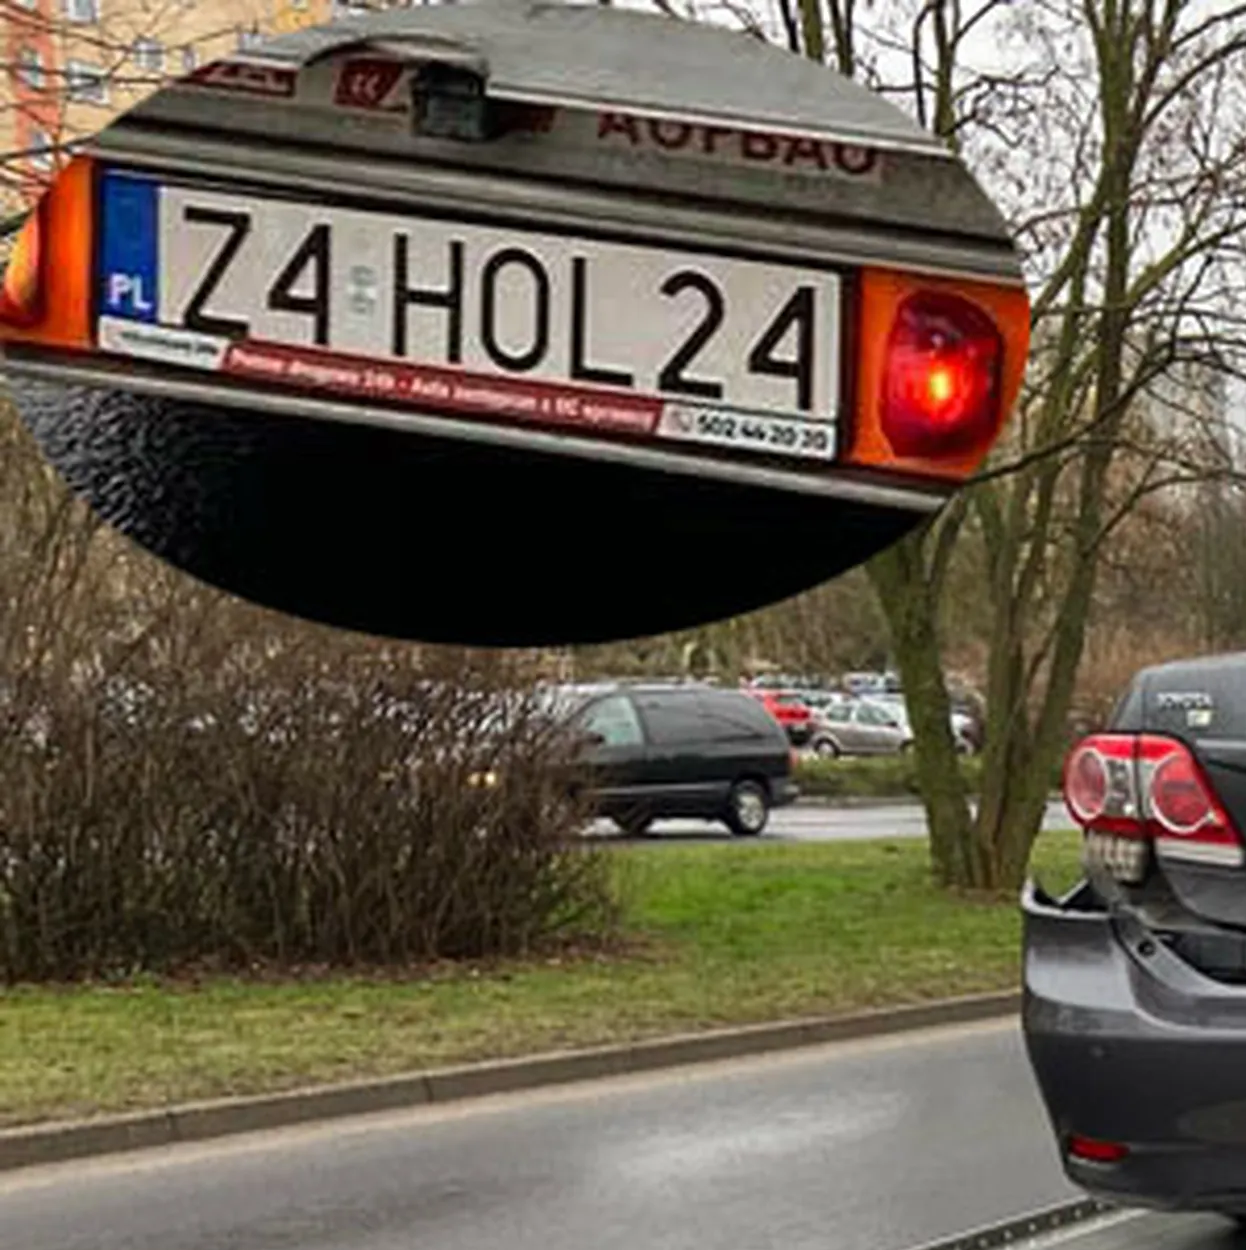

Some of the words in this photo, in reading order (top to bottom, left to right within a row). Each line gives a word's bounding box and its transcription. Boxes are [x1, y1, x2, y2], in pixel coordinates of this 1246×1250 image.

[109, 273, 153, 309] PL
[183, 206, 332, 345] Z4
[393, 232, 816, 410] HOL24
